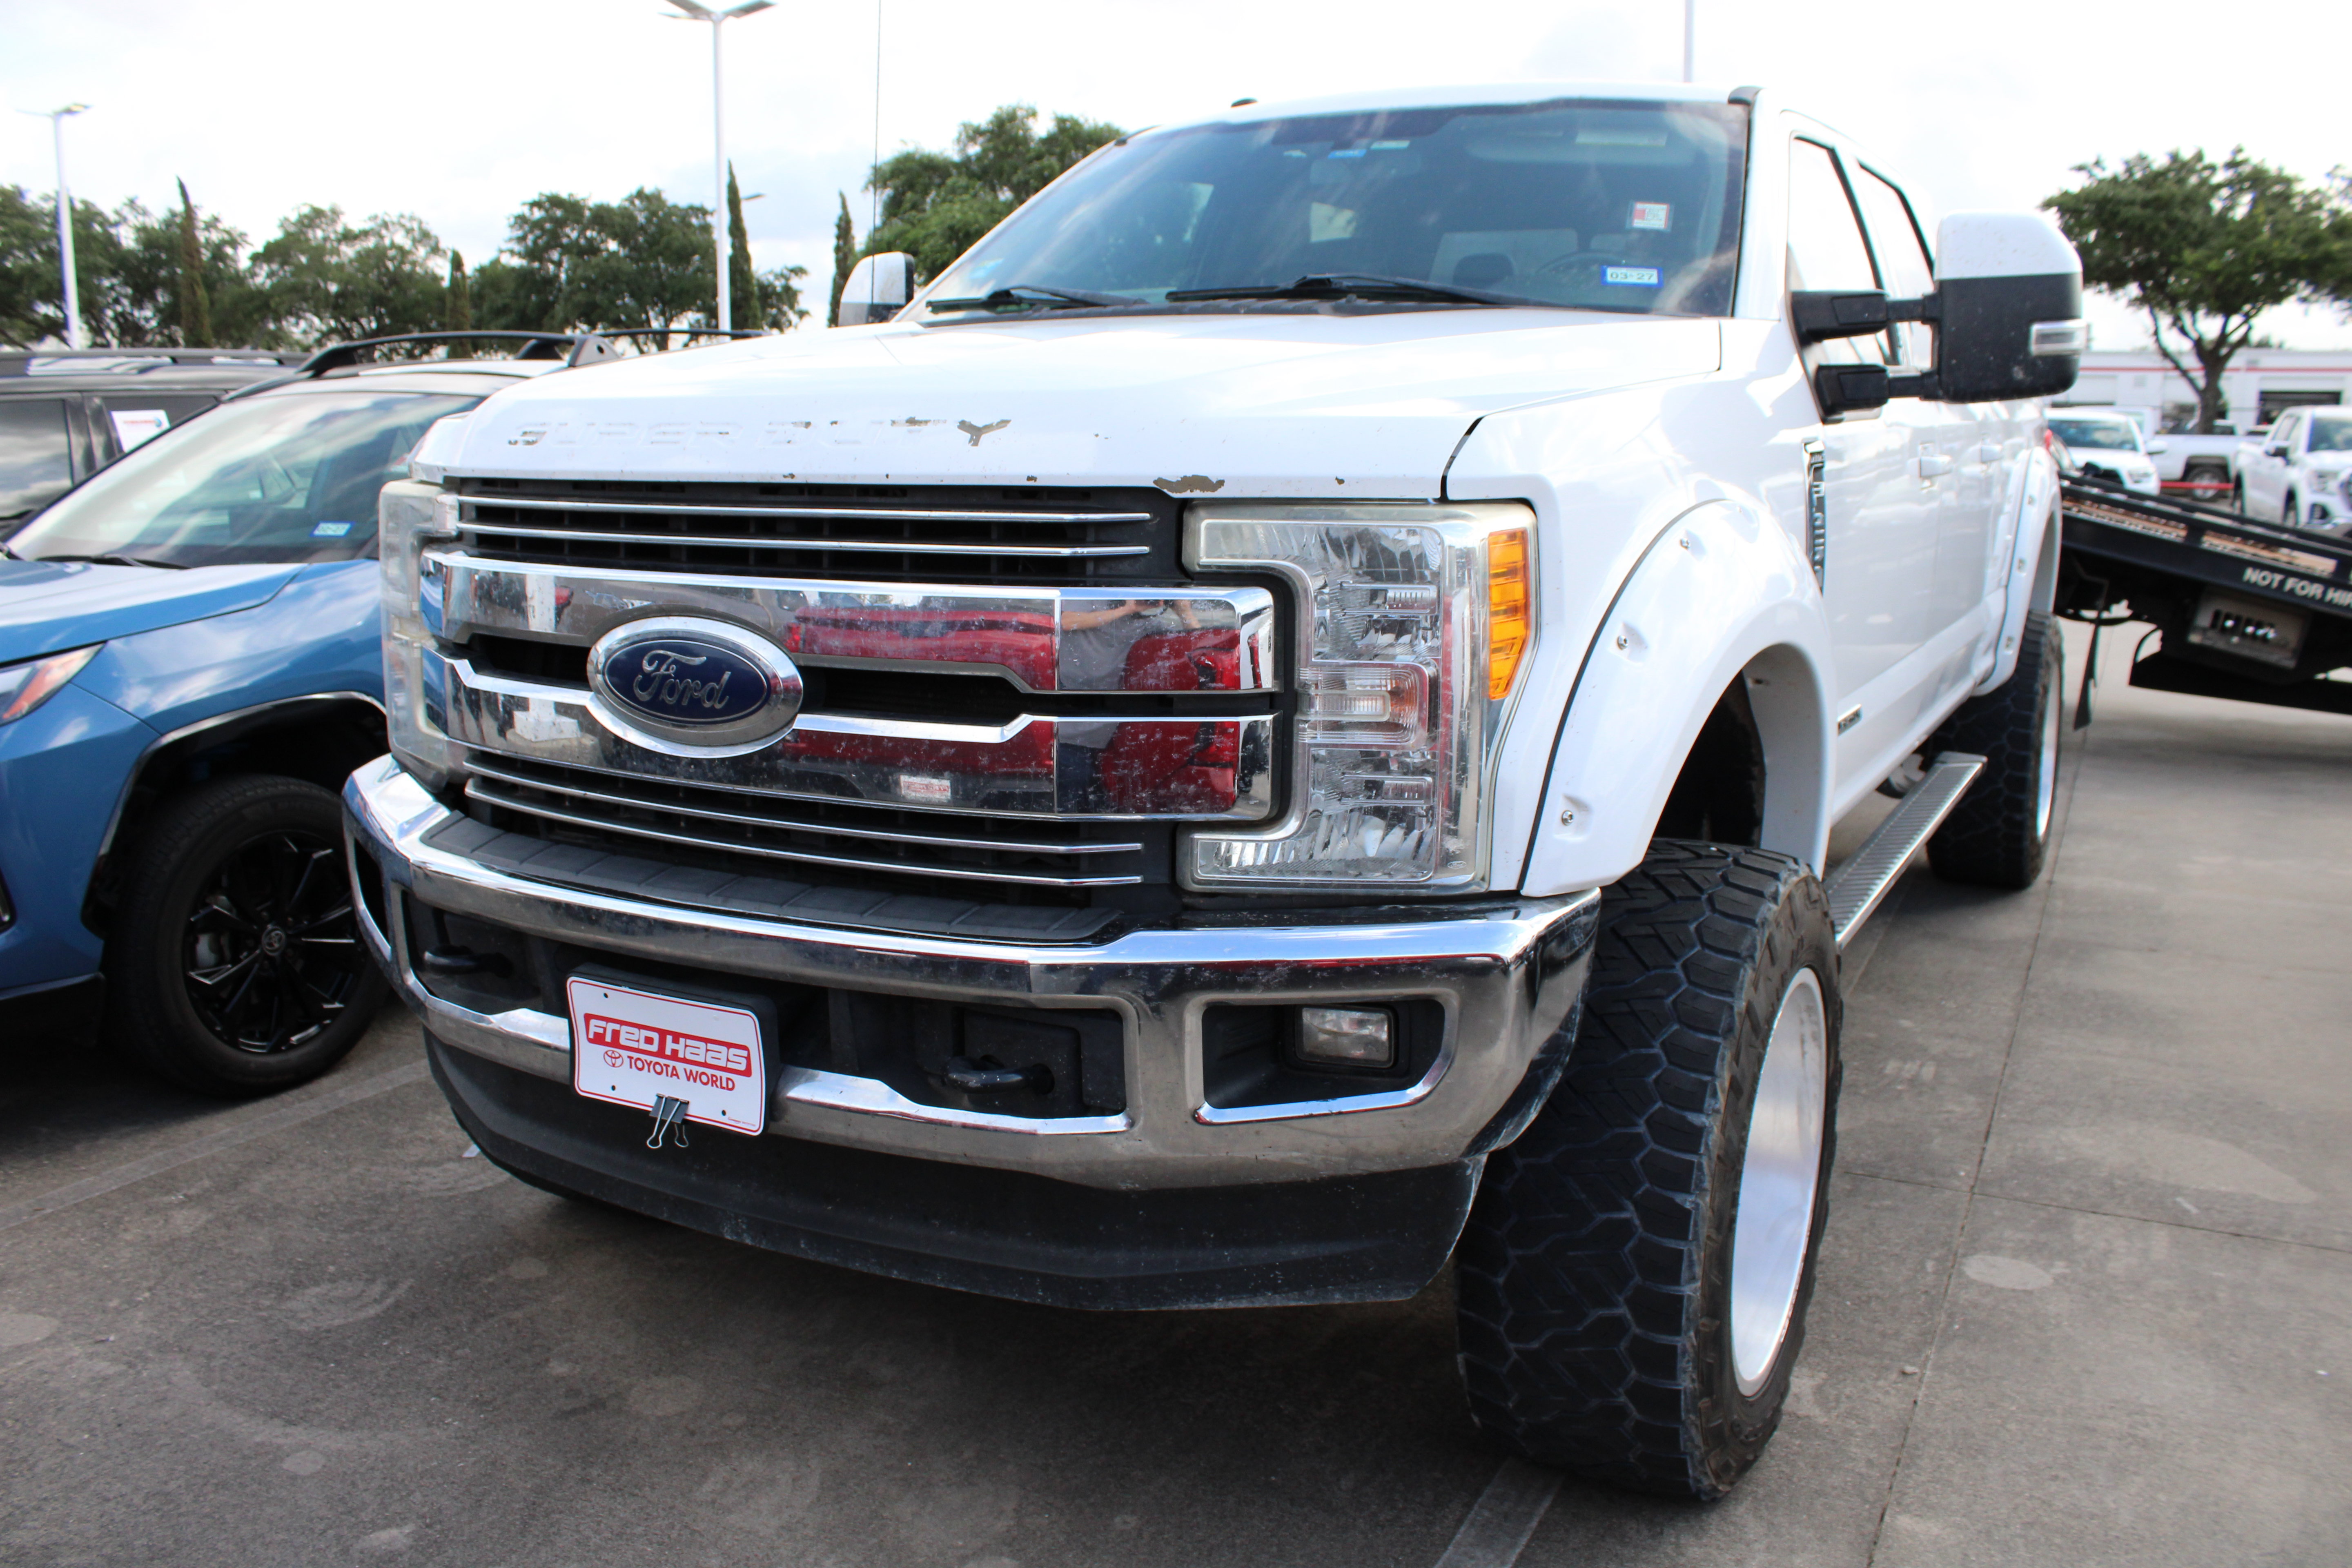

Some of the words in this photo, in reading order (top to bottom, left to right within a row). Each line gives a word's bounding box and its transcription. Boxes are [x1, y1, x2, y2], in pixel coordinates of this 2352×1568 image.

[1610, 272, 1653, 281] 03-27
[2243, 567, 2285, 589] NOT
[2283, 577, 2324, 600] FOR
[633, 649, 731, 709] Ford
[628, 1056, 679, 1080] TOYOTA
[684, 1068, 735, 1091] WORLD
